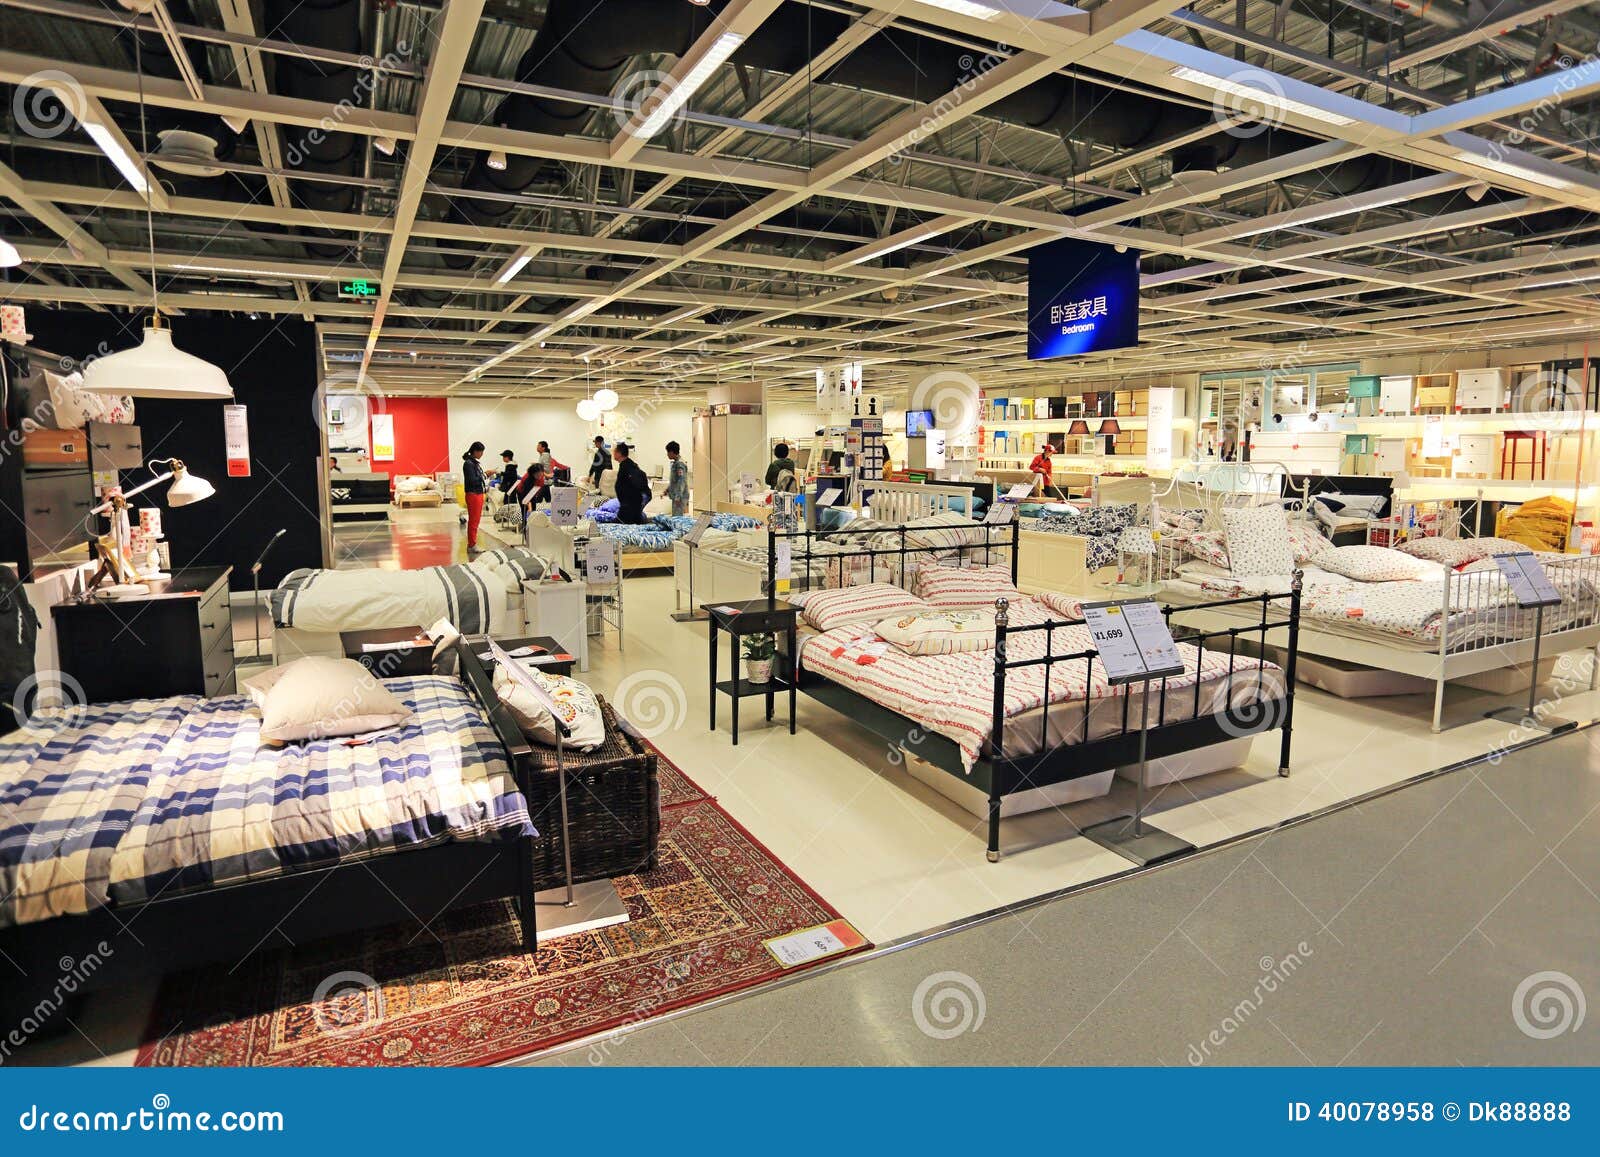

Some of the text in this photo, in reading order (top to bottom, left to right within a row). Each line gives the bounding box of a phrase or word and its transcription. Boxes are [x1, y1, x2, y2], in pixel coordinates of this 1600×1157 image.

[1050, 295, 1108, 325] 卧室家具
[1062, 323, 1095, 335] Bedroom
[1094, 628, 1123, 642] ¥1,699
